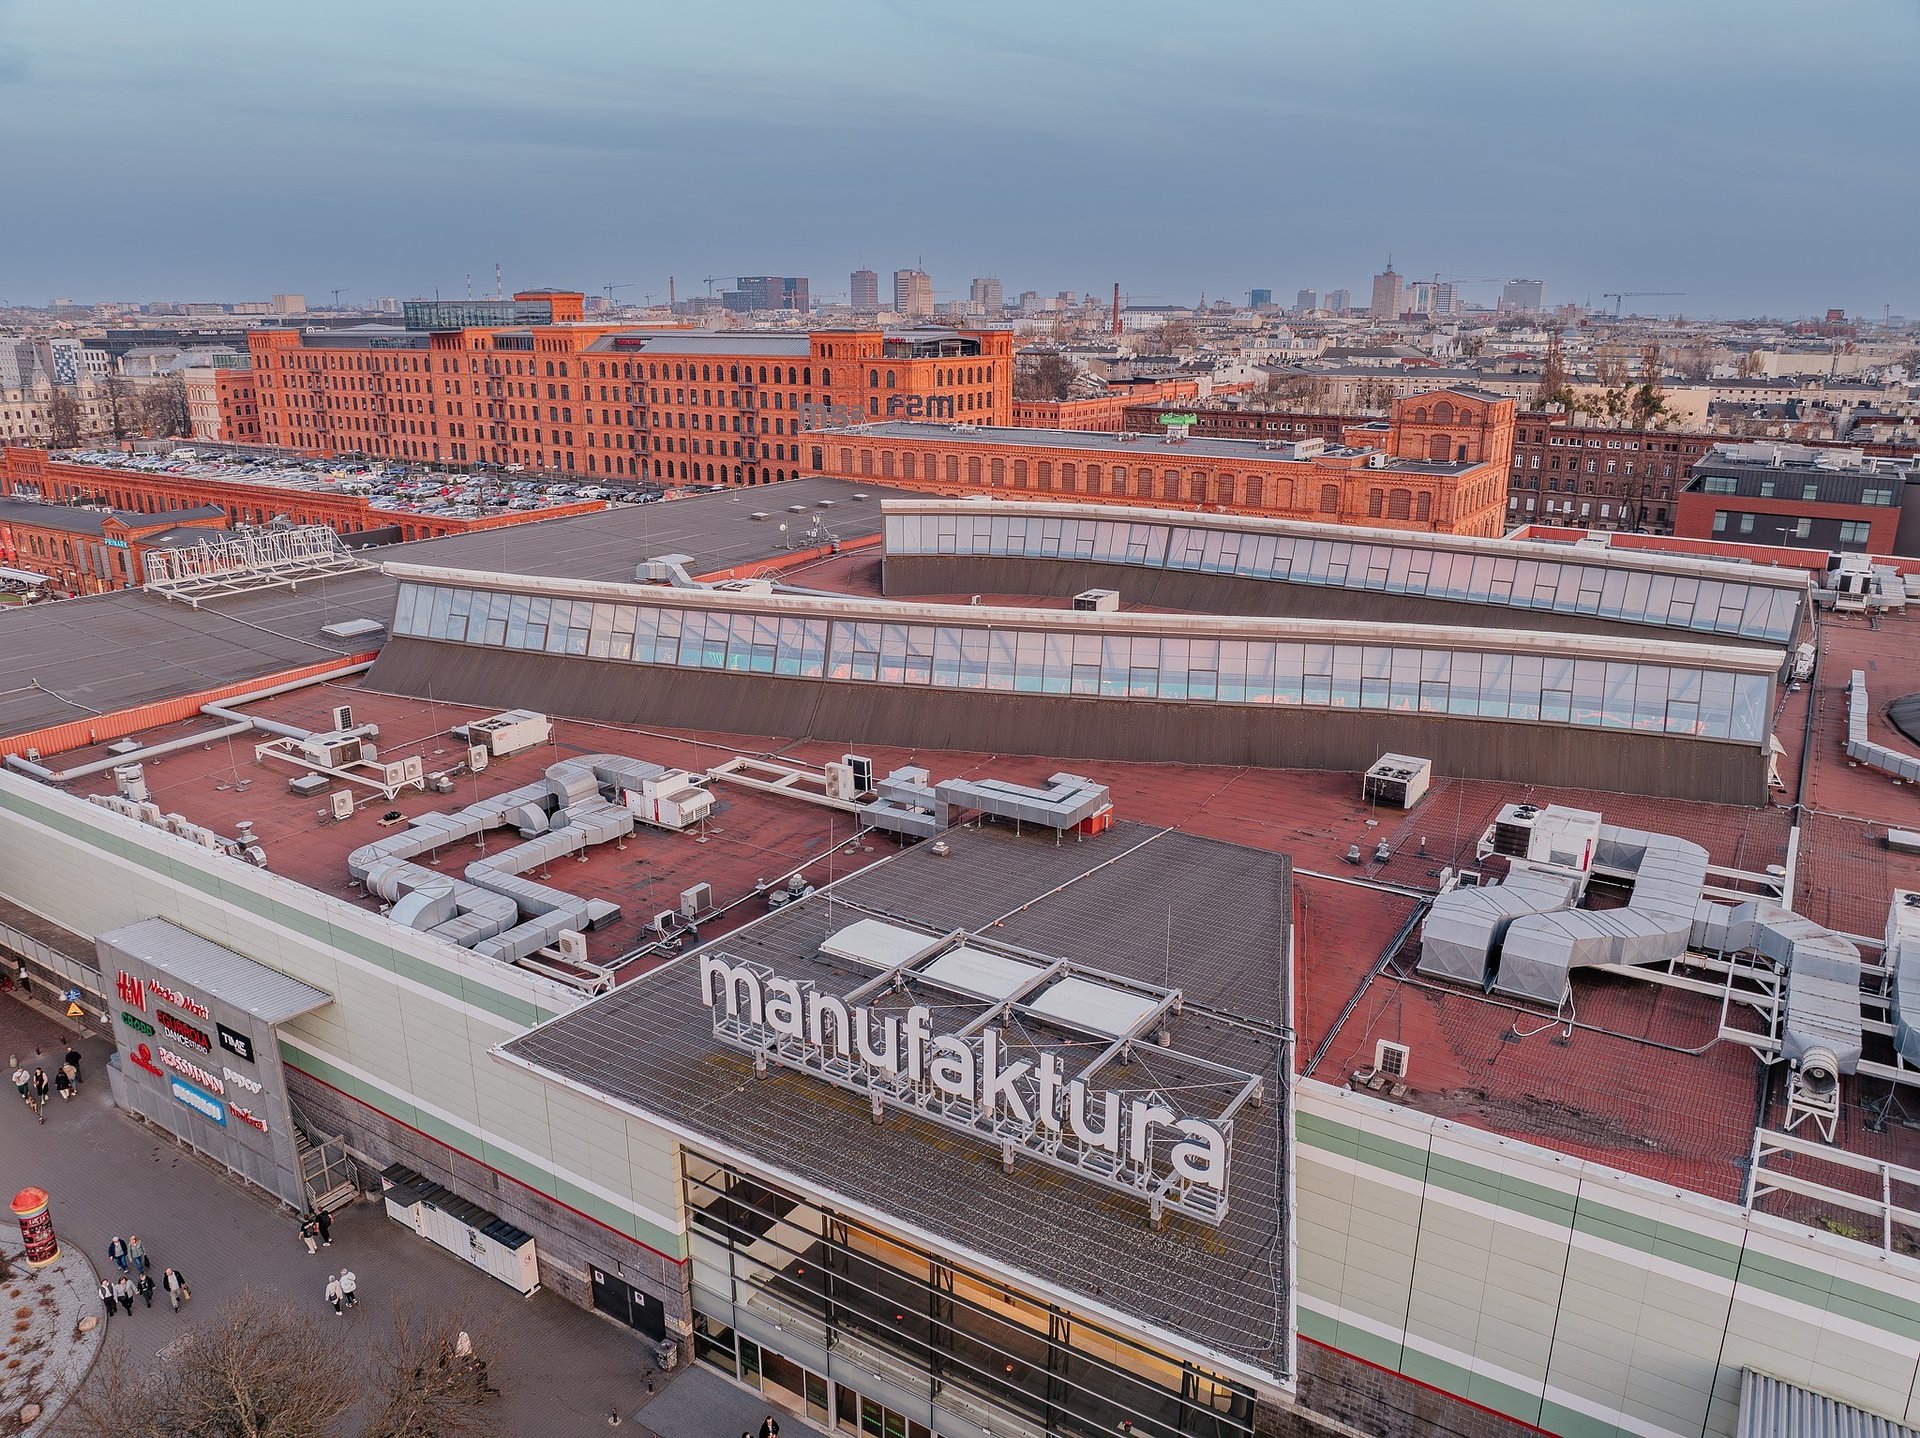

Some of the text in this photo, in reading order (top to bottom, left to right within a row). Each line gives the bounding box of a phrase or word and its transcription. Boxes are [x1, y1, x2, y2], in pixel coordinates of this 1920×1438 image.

[116, 970, 147, 1012] H&M
[156, 1009, 211, 1048] EGURROLA
[221, 1032, 247, 1053] TIME
[158, 1046, 225, 1095] ROSSMANN
[222, 1066, 262, 1094] pepco
[699, 953, 1230, 1190] manufaktura
